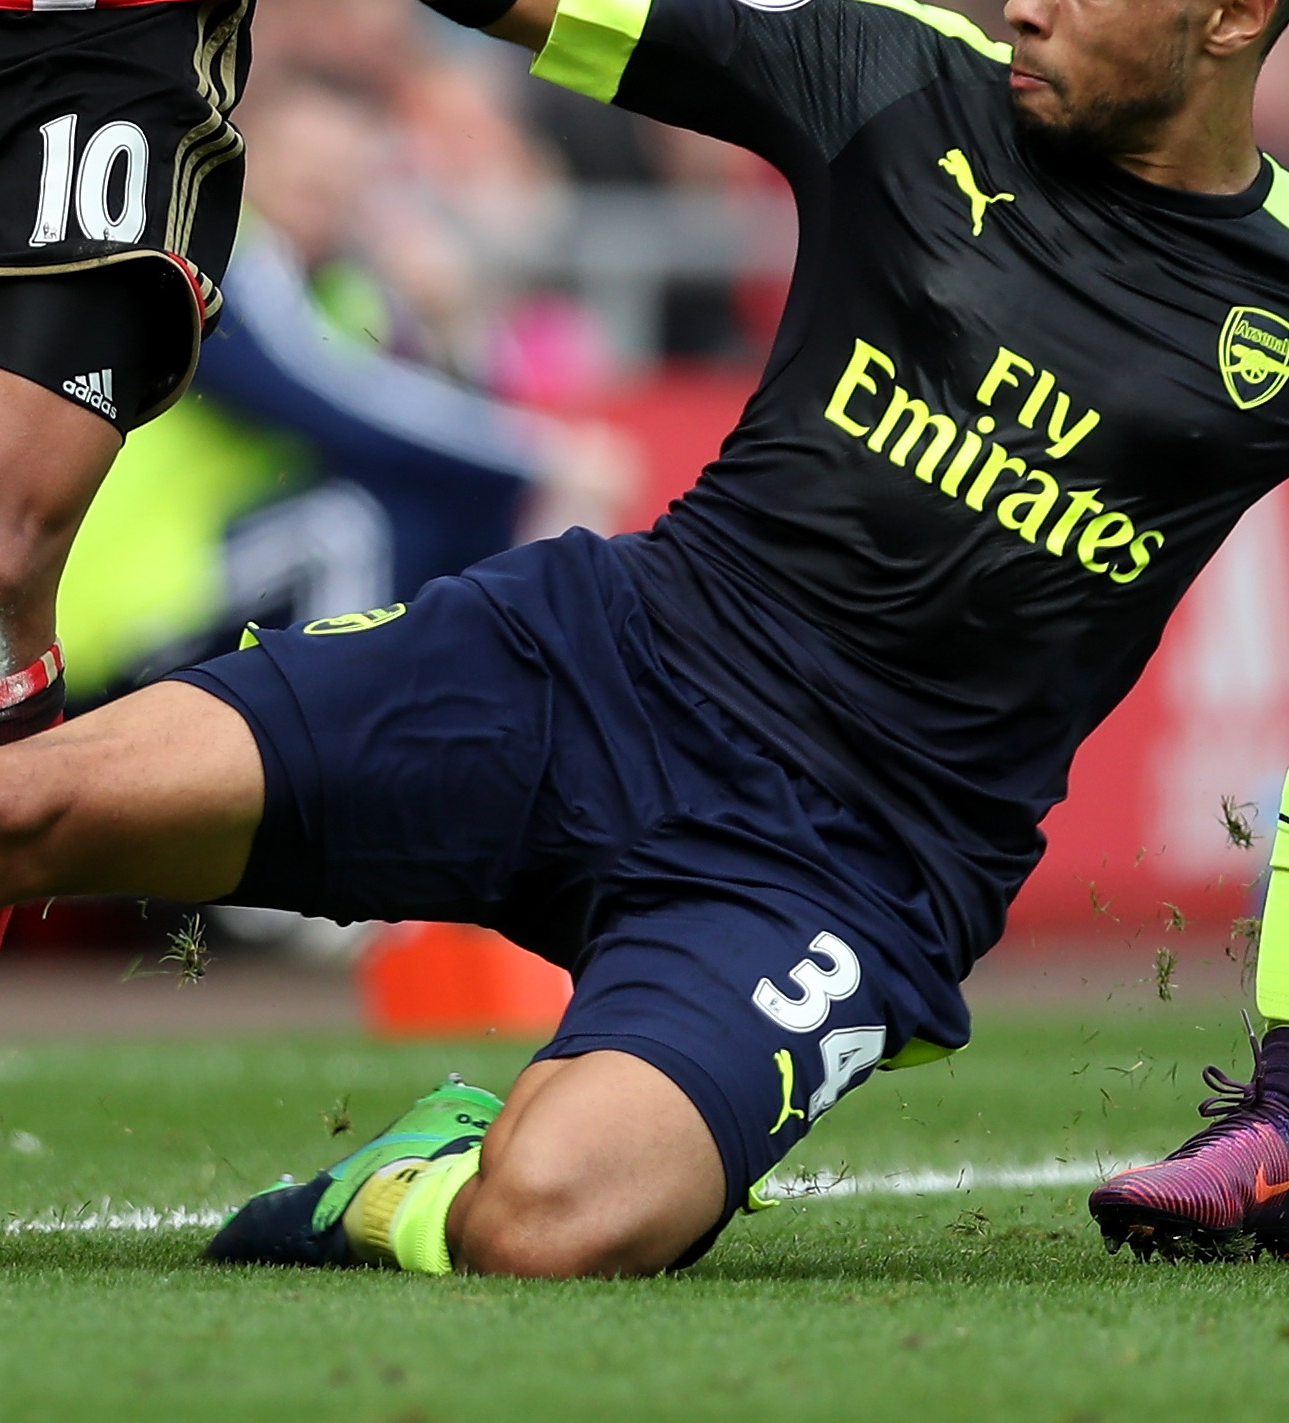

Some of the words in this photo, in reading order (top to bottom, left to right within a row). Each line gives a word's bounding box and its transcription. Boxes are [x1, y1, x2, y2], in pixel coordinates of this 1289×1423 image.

[29, 114, 149, 246] 10
[61, 379, 118, 420] adidas
[823, 337, 1166, 585] Emirates
[975, 345, 1102, 460] Fly
[752, 931, 886, 1122] 34
